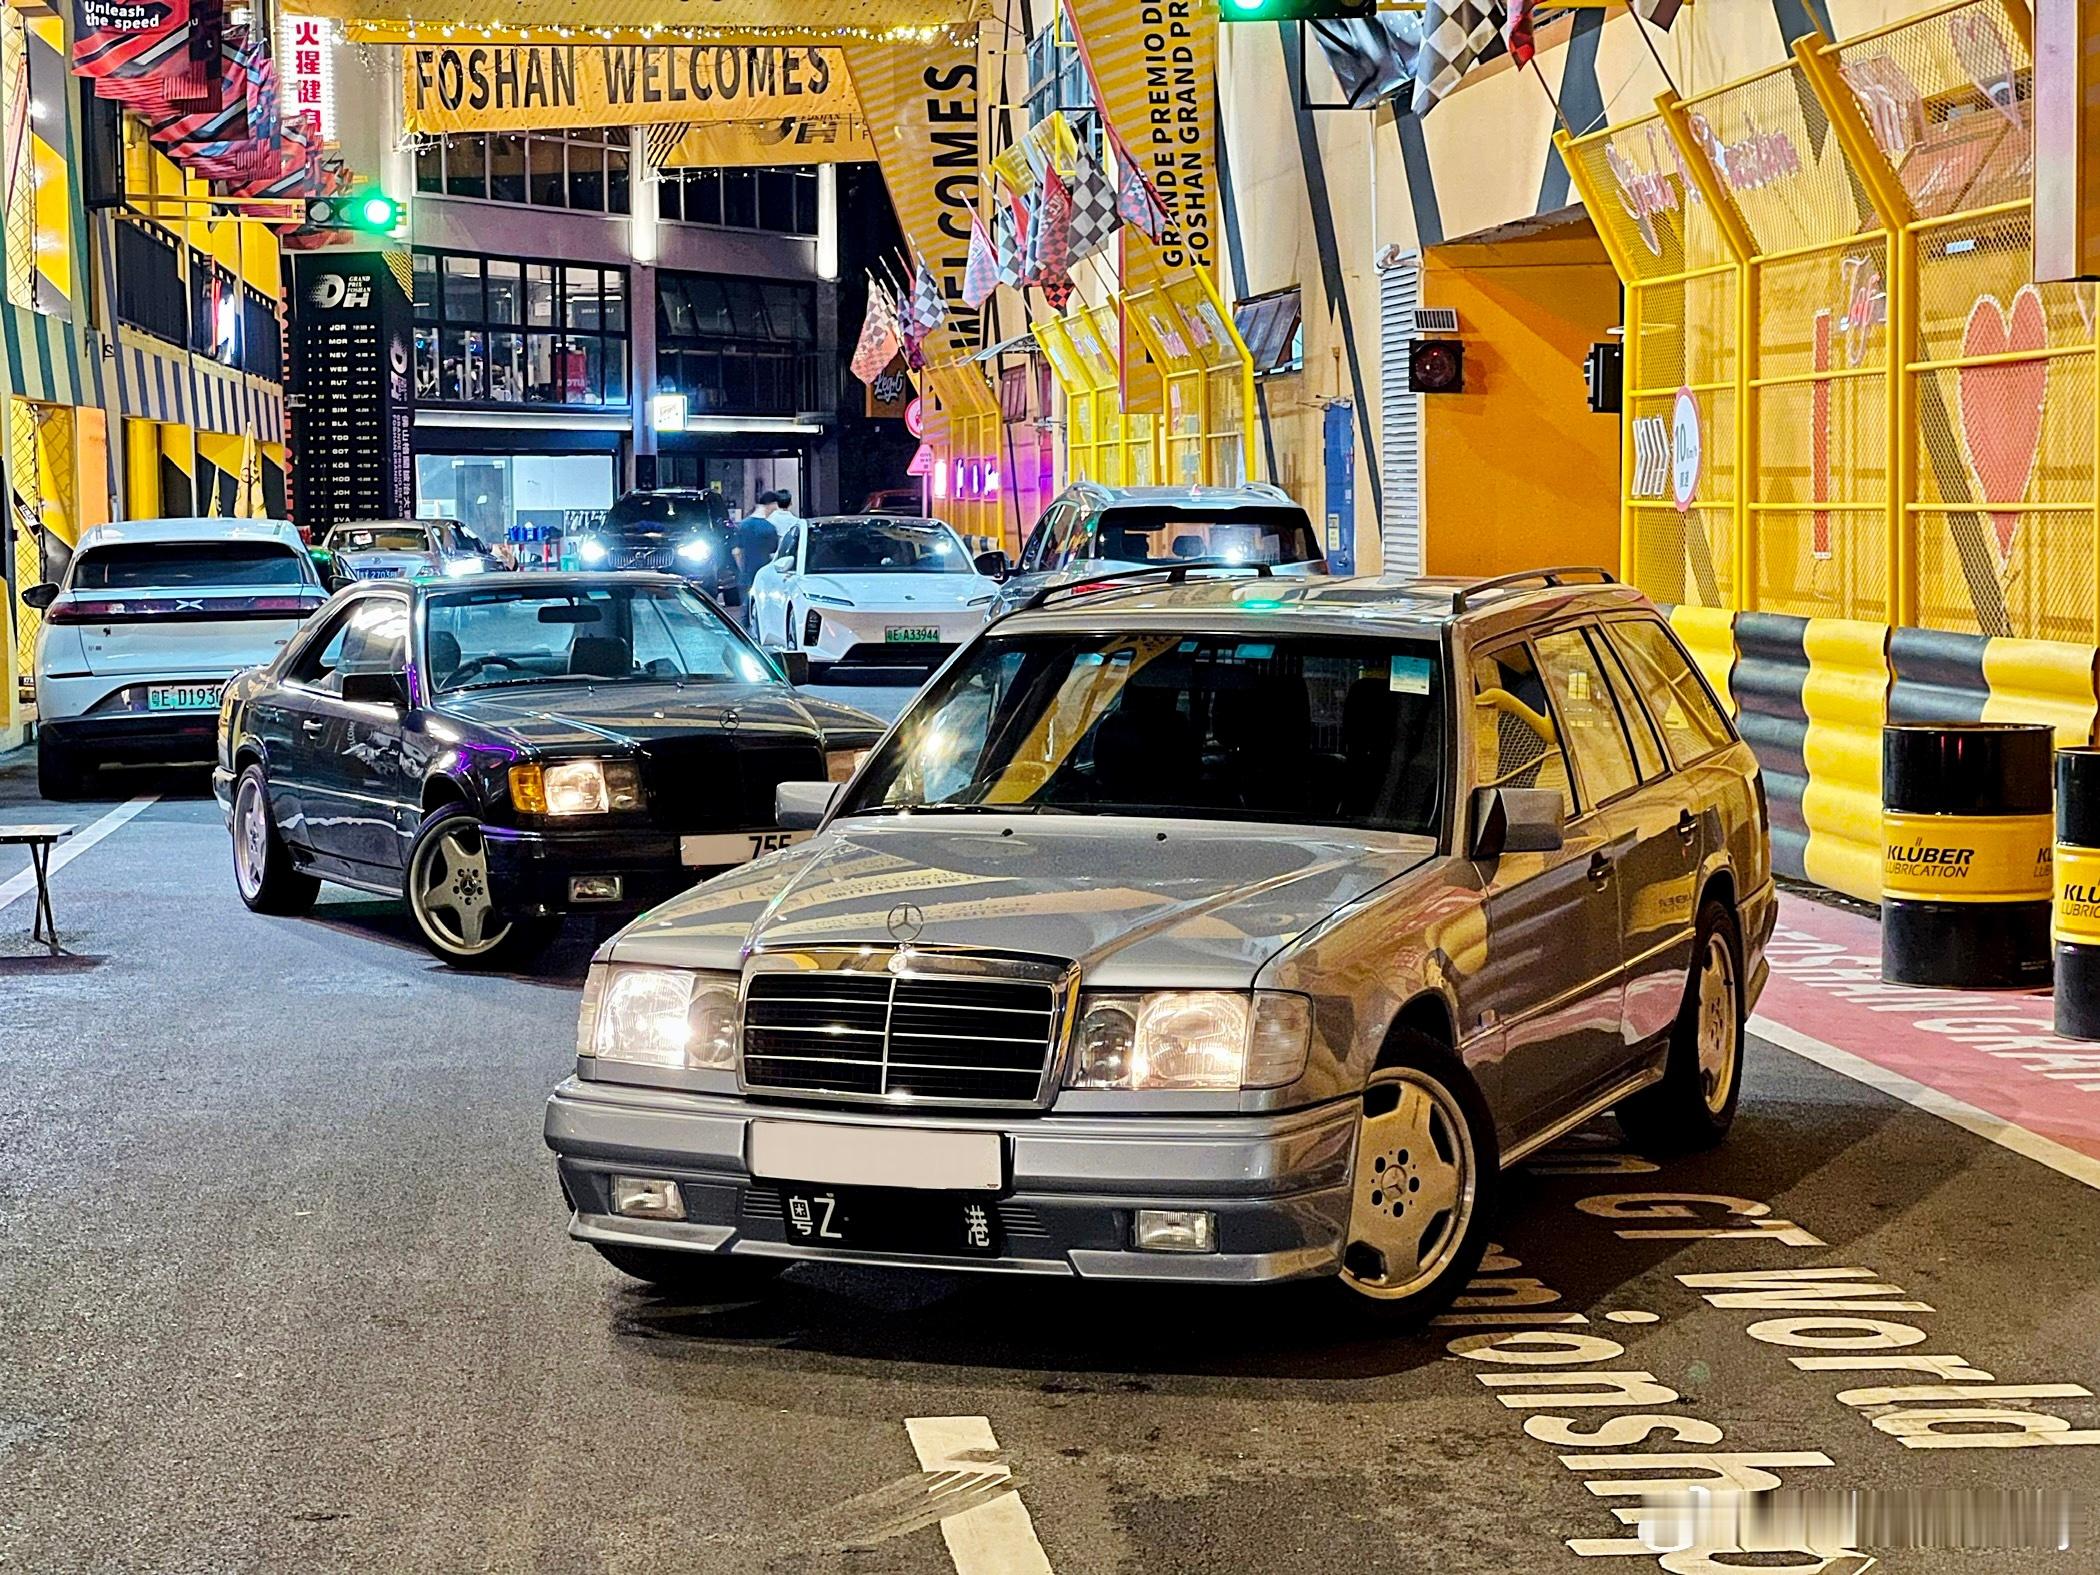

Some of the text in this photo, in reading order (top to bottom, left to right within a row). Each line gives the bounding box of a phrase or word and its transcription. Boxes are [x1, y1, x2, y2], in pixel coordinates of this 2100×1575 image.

[85, 1, 144, 17] Unleash
[85, 13, 159, 31] the speed
[416, 46, 830, 110] FOSHAN WELCOMES
[1144, 33, 1173, 144] PREMIO
[1173, 46, 1201, 144] GRAND
[1180, 153, 1211, 267] FOSHAN
[1676, 423, 1687, 464] 10
[152, 689, 170, 706] 粤E
[1885, 863, 1969, 878] LUBRICATION
[789, 1195, 990, 1247] 粤Z 港
[1575, 1192, 2100, 1450] GT World
